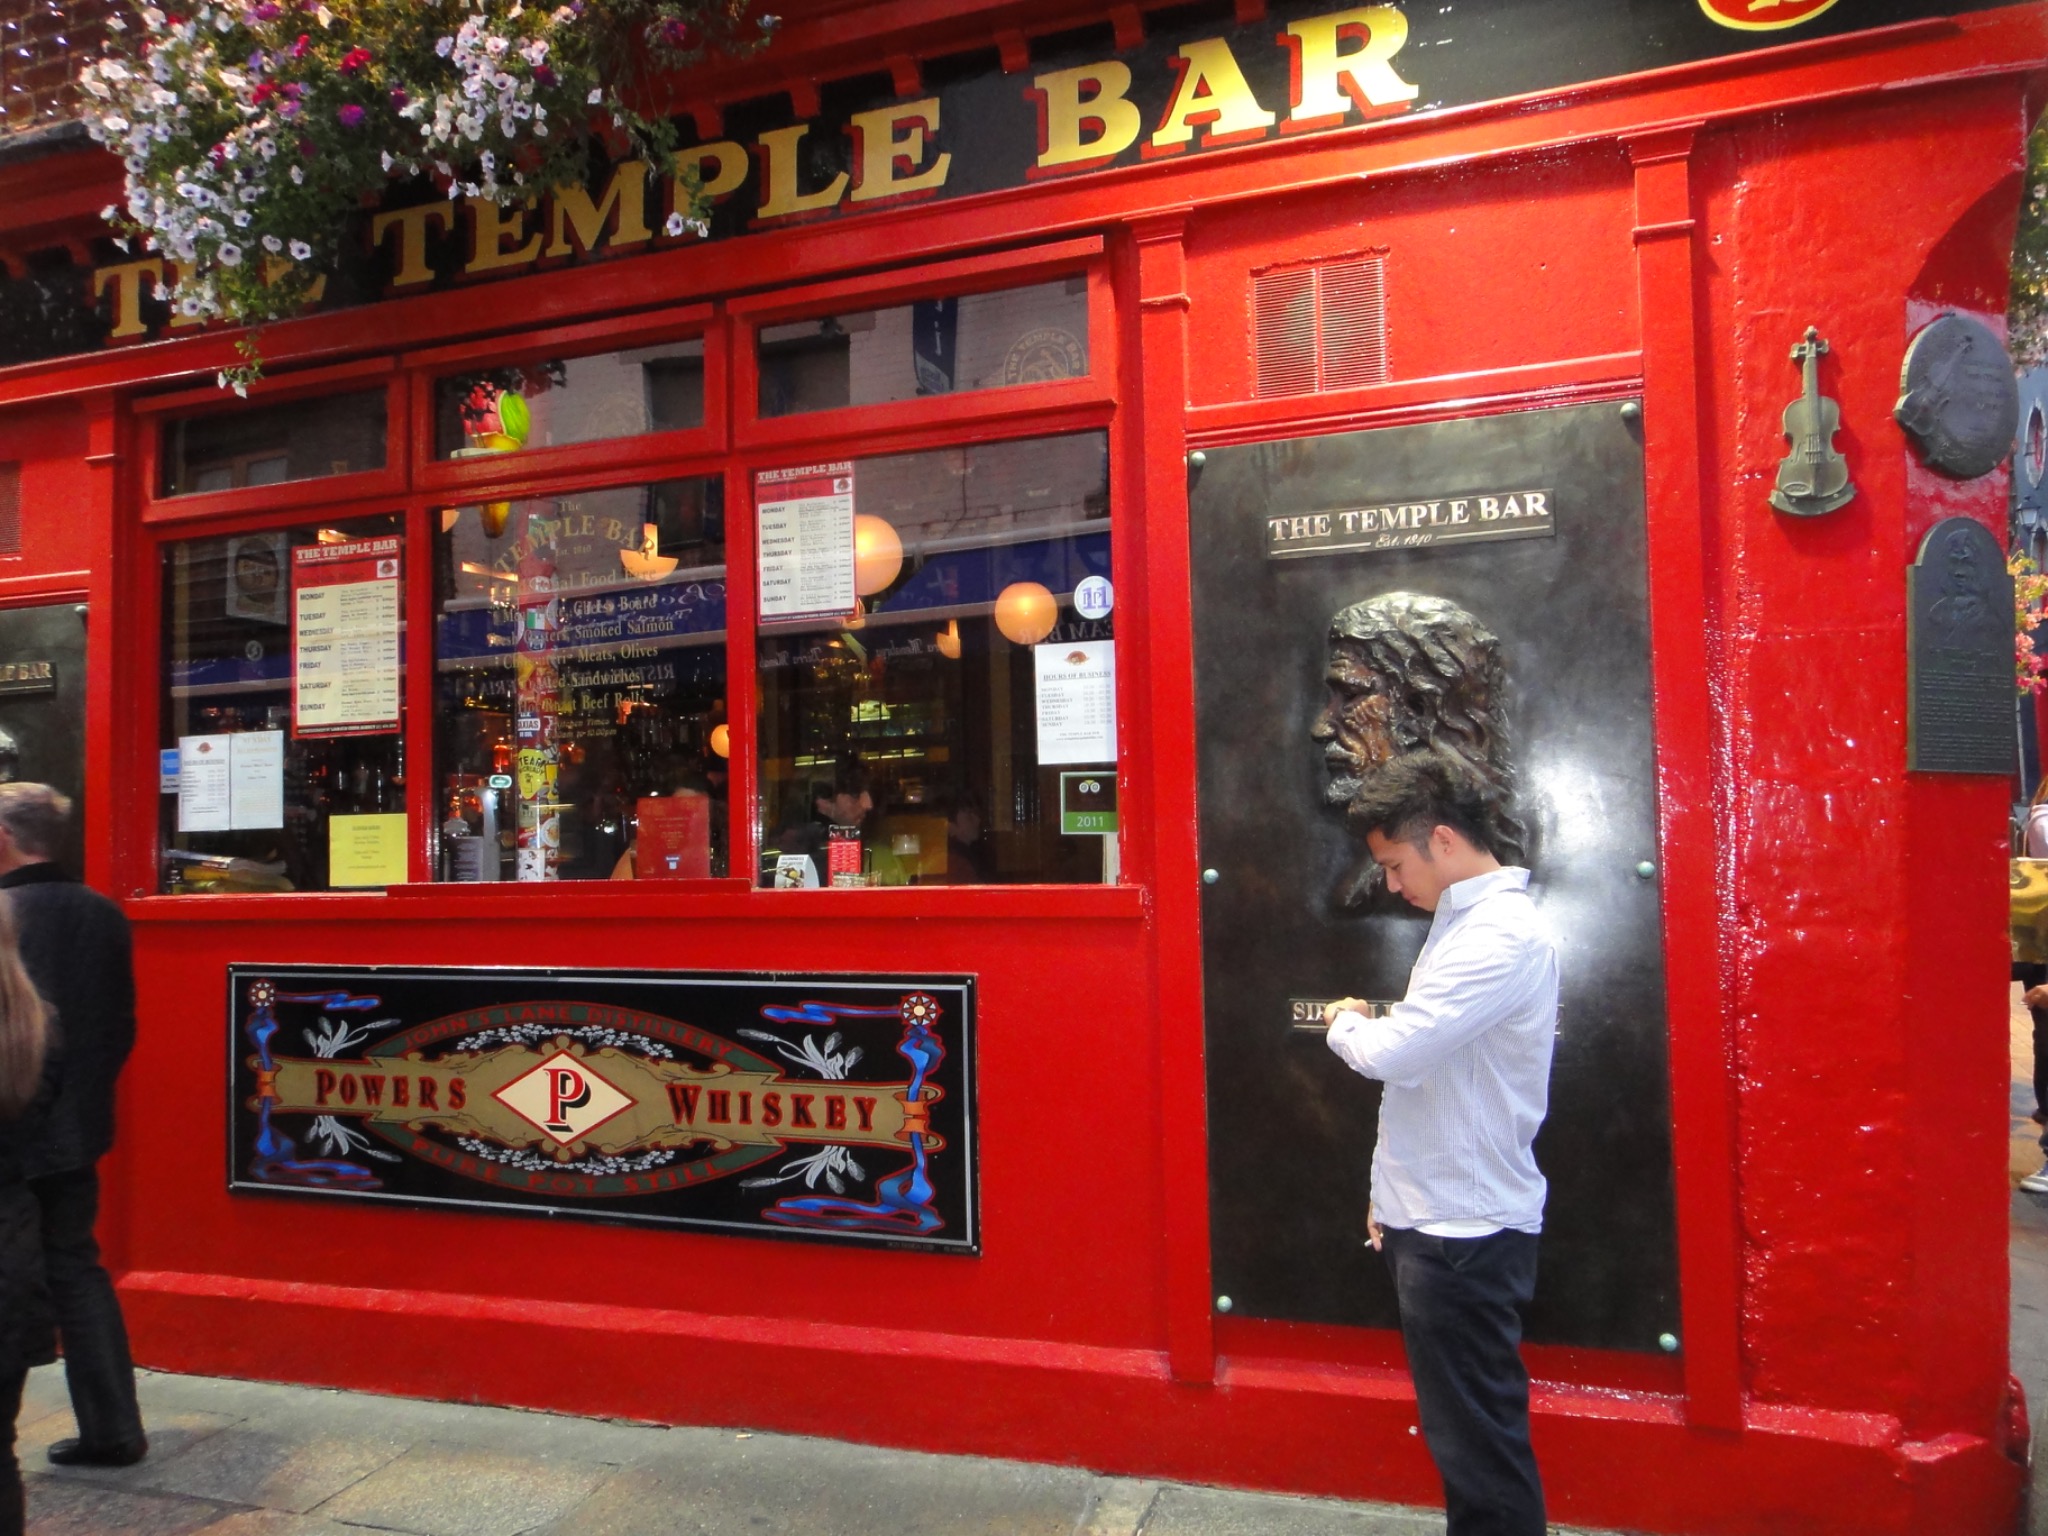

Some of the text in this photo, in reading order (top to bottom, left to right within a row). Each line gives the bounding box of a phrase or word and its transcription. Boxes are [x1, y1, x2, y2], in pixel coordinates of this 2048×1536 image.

[372, 98, 951, 286] TEMPLE
[1030, 6, 1419, 170] BAR
[758, 461, 852, 480] THE TEMPLE BAR
[560, 500, 582, 512] The
[762, 506, 785, 514] MONDAY
[1268, 492, 1549, 541] THE TEMPLE BAR
[494, 514, 655, 572] TEMPLE BAR
[762, 537, 795, 545] WEDNESDAY
[1375, 533, 1433, 548] Est. 1840
[296, 549, 320, 560] THE
[322, 543, 371, 557] TEMPLE
[373, 539, 397, 550] BAR
[581, 569, 616, 586] Food
[763, 578, 791, 586] SATURDAY
[300, 592, 325, 600] MONDAY
[620, 593, 659, 611] Board
[300, 612, 326, 621] TUESDAY
[300, 627, 334, 636] WEDNESDAY
[574, 618, 623, 639] Smoked
[627, 619, 675, 634] Salmon
[300, 644, 332, 653] THURSDAY
[577, 649, 617, 664] Meats,
[621, 643, 659, 659] Olives
[18, 662, 53, 680] BAR
[300, 661, 321, 670] FRIDAY
[570, 668, 641, 687] Sandwiches
[1043, 670, 1112, 682] HOURS OF BUSINESS
[300, 682, 332, 690] SATURDAY
[300, 703, 326, 712] SUNDAY
[582, 692, 609, 709] Beef
[1077, 816, 1104, 827] 2011
[404, 1005, 733, 1057] JOHN'S LANE DISTILLERY
[314, 1067, 877, 1132] POWERS P WHISKEY
[411, 1136, 726, 1194] PURE POT STILL
